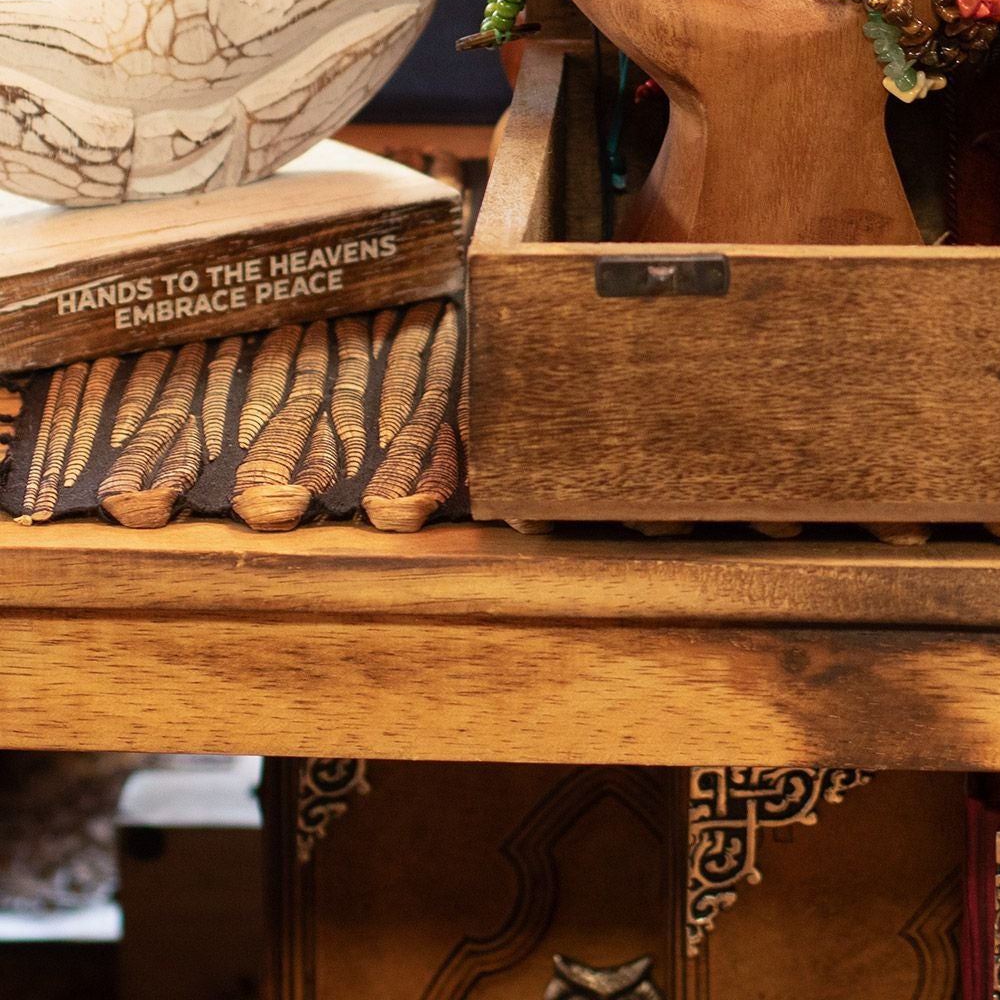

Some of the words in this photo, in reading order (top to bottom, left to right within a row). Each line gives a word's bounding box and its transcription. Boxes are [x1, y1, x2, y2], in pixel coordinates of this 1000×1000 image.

[57, 278, 153, 315] HANDS
[161, 271, 199, 296] TO
[206, 259, 261, 286] THE
[269, 236, 397, 275] HEAVENS
[115, 289, 247, 330] EMBRACE
[255, 269, 343, 303] PEACE
